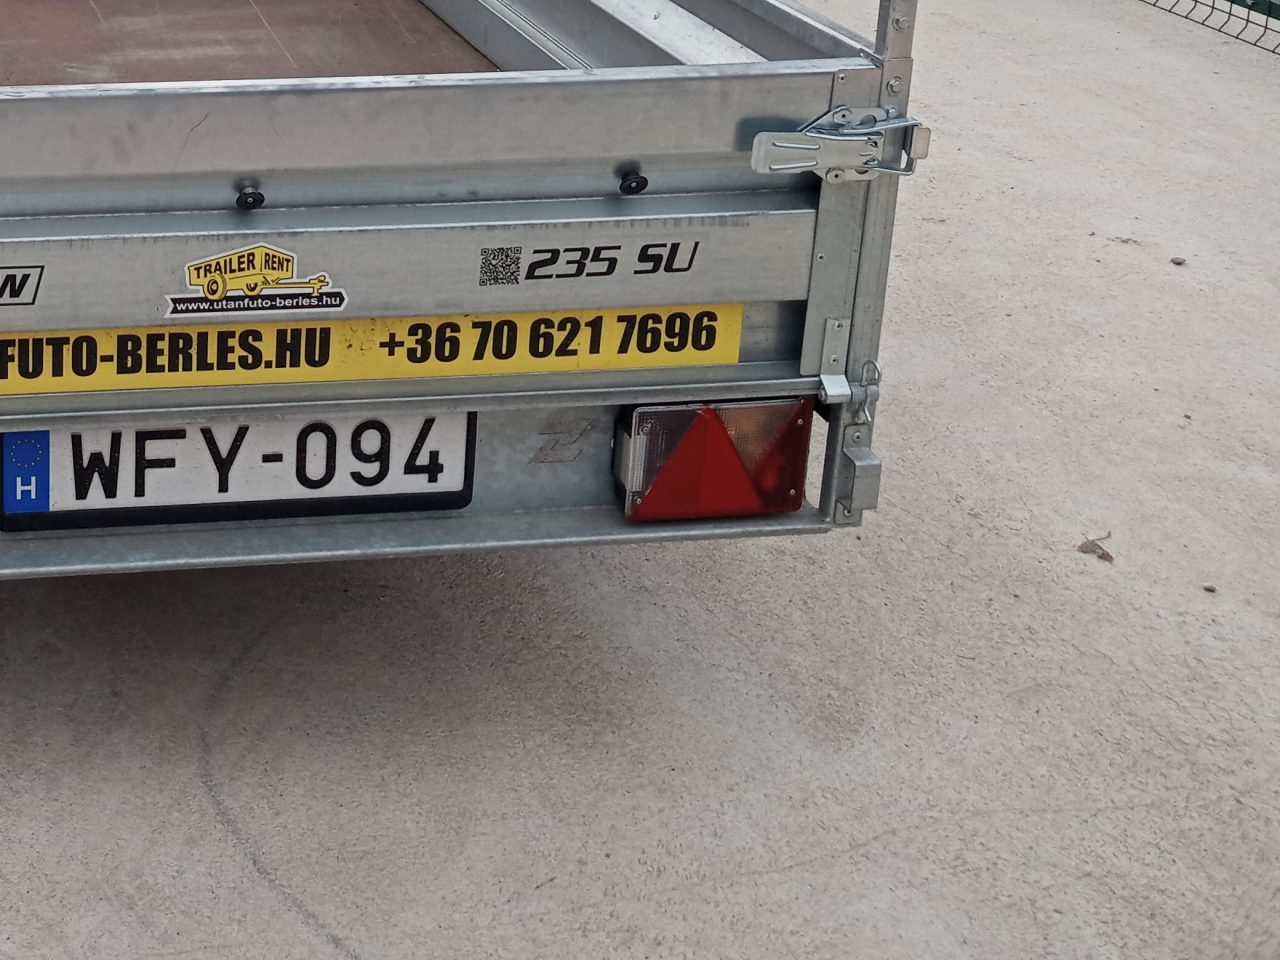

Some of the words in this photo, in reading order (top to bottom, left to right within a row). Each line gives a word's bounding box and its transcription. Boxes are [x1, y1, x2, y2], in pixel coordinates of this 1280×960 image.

[193, 251, 256, 280] TRAILER
[263, 252, 291, 273] RENT
[524, 244, 622, 281] 235
[633, 240, 700, 276] SU
[175, 295, 341, 311] www.utanfuto-berles.hu
[378, 321, 461, 364] +36
[472, 318, 518, 361] 70
[528, 314, 604, 359] 621
[616, 310, 718, 355] 7696
[15, 475, 37, 500] H
[70, 417, 445, 501] WFY-094
